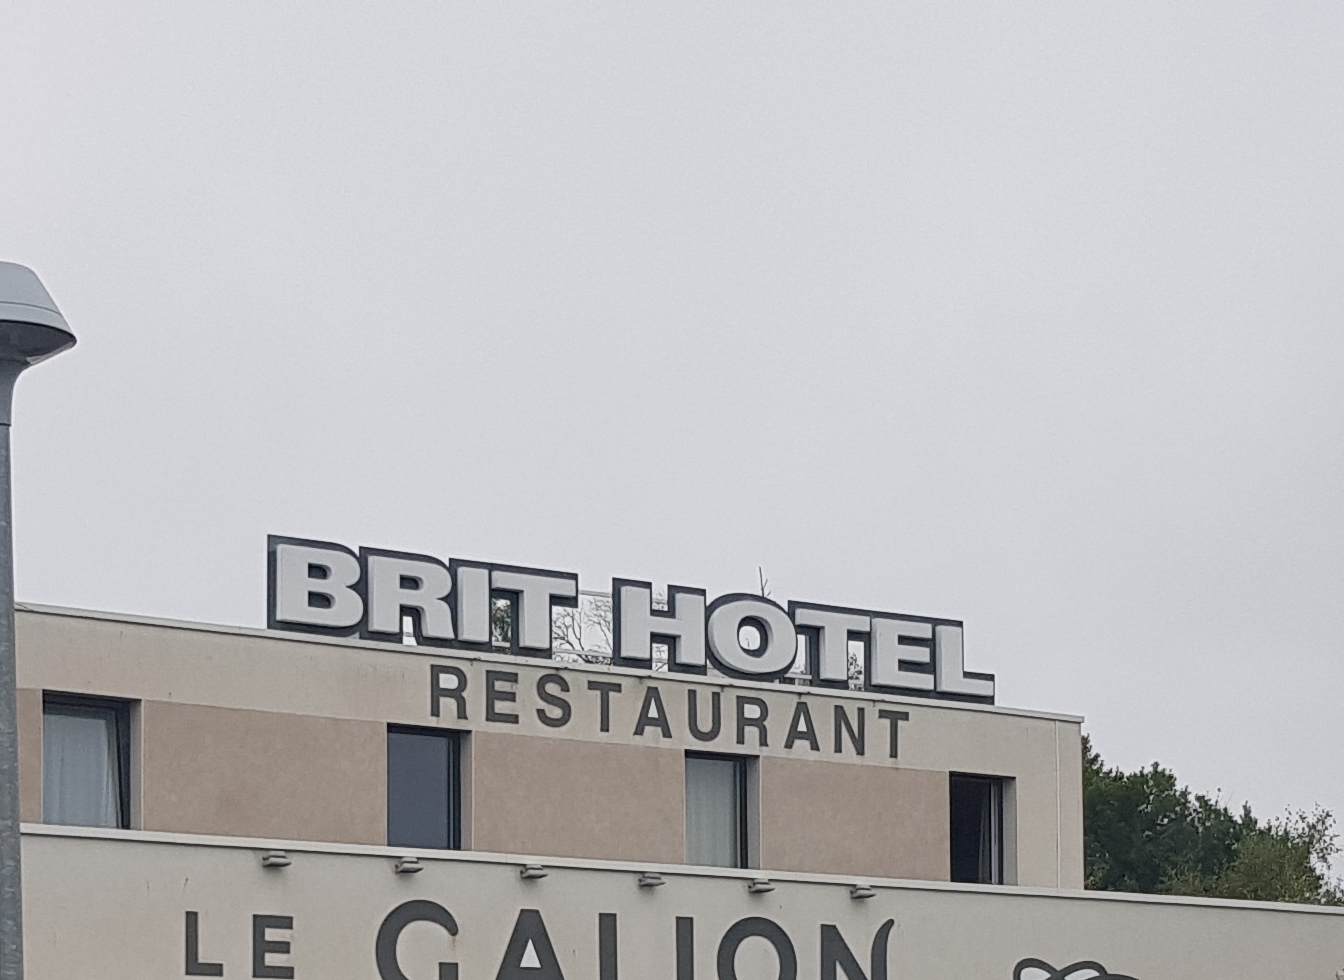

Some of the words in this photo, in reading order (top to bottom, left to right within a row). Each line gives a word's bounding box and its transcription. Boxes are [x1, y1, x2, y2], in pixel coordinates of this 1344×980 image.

[267, 534, 579, 660] BRIT
[612, 577, 995, 705] HOTEL
[430, 663, 910, 759] RESTAURANT
[185, 910, 295, 980] LE
